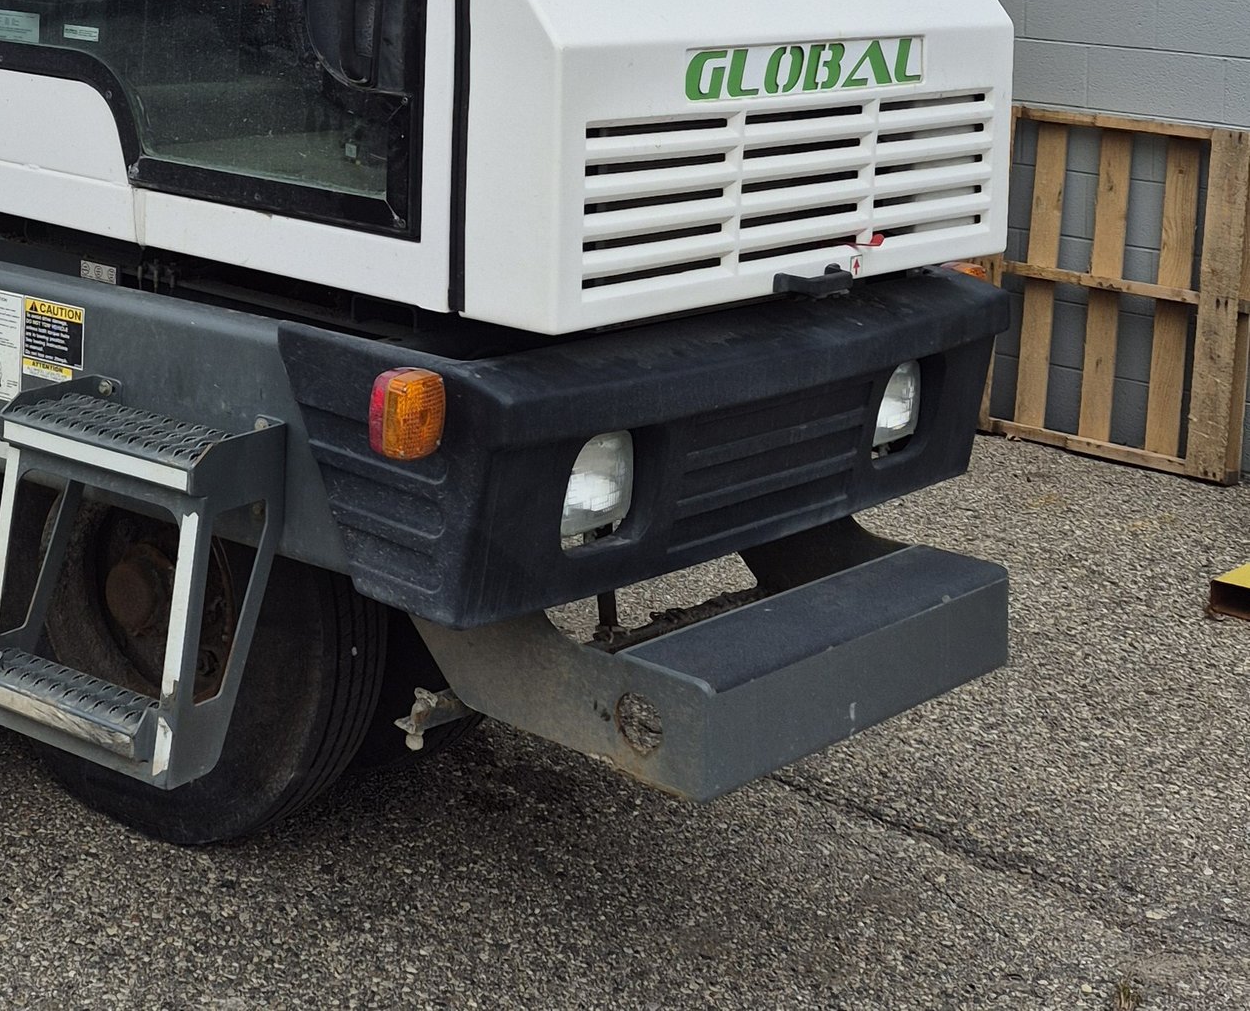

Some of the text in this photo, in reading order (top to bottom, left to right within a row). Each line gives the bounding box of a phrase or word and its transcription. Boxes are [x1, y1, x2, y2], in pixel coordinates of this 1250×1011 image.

[685, 38, 922, 101] GLOBAL
[40, 303, 82, 321] CAUTION
[32, 361, 64, 373] ATTENTION
